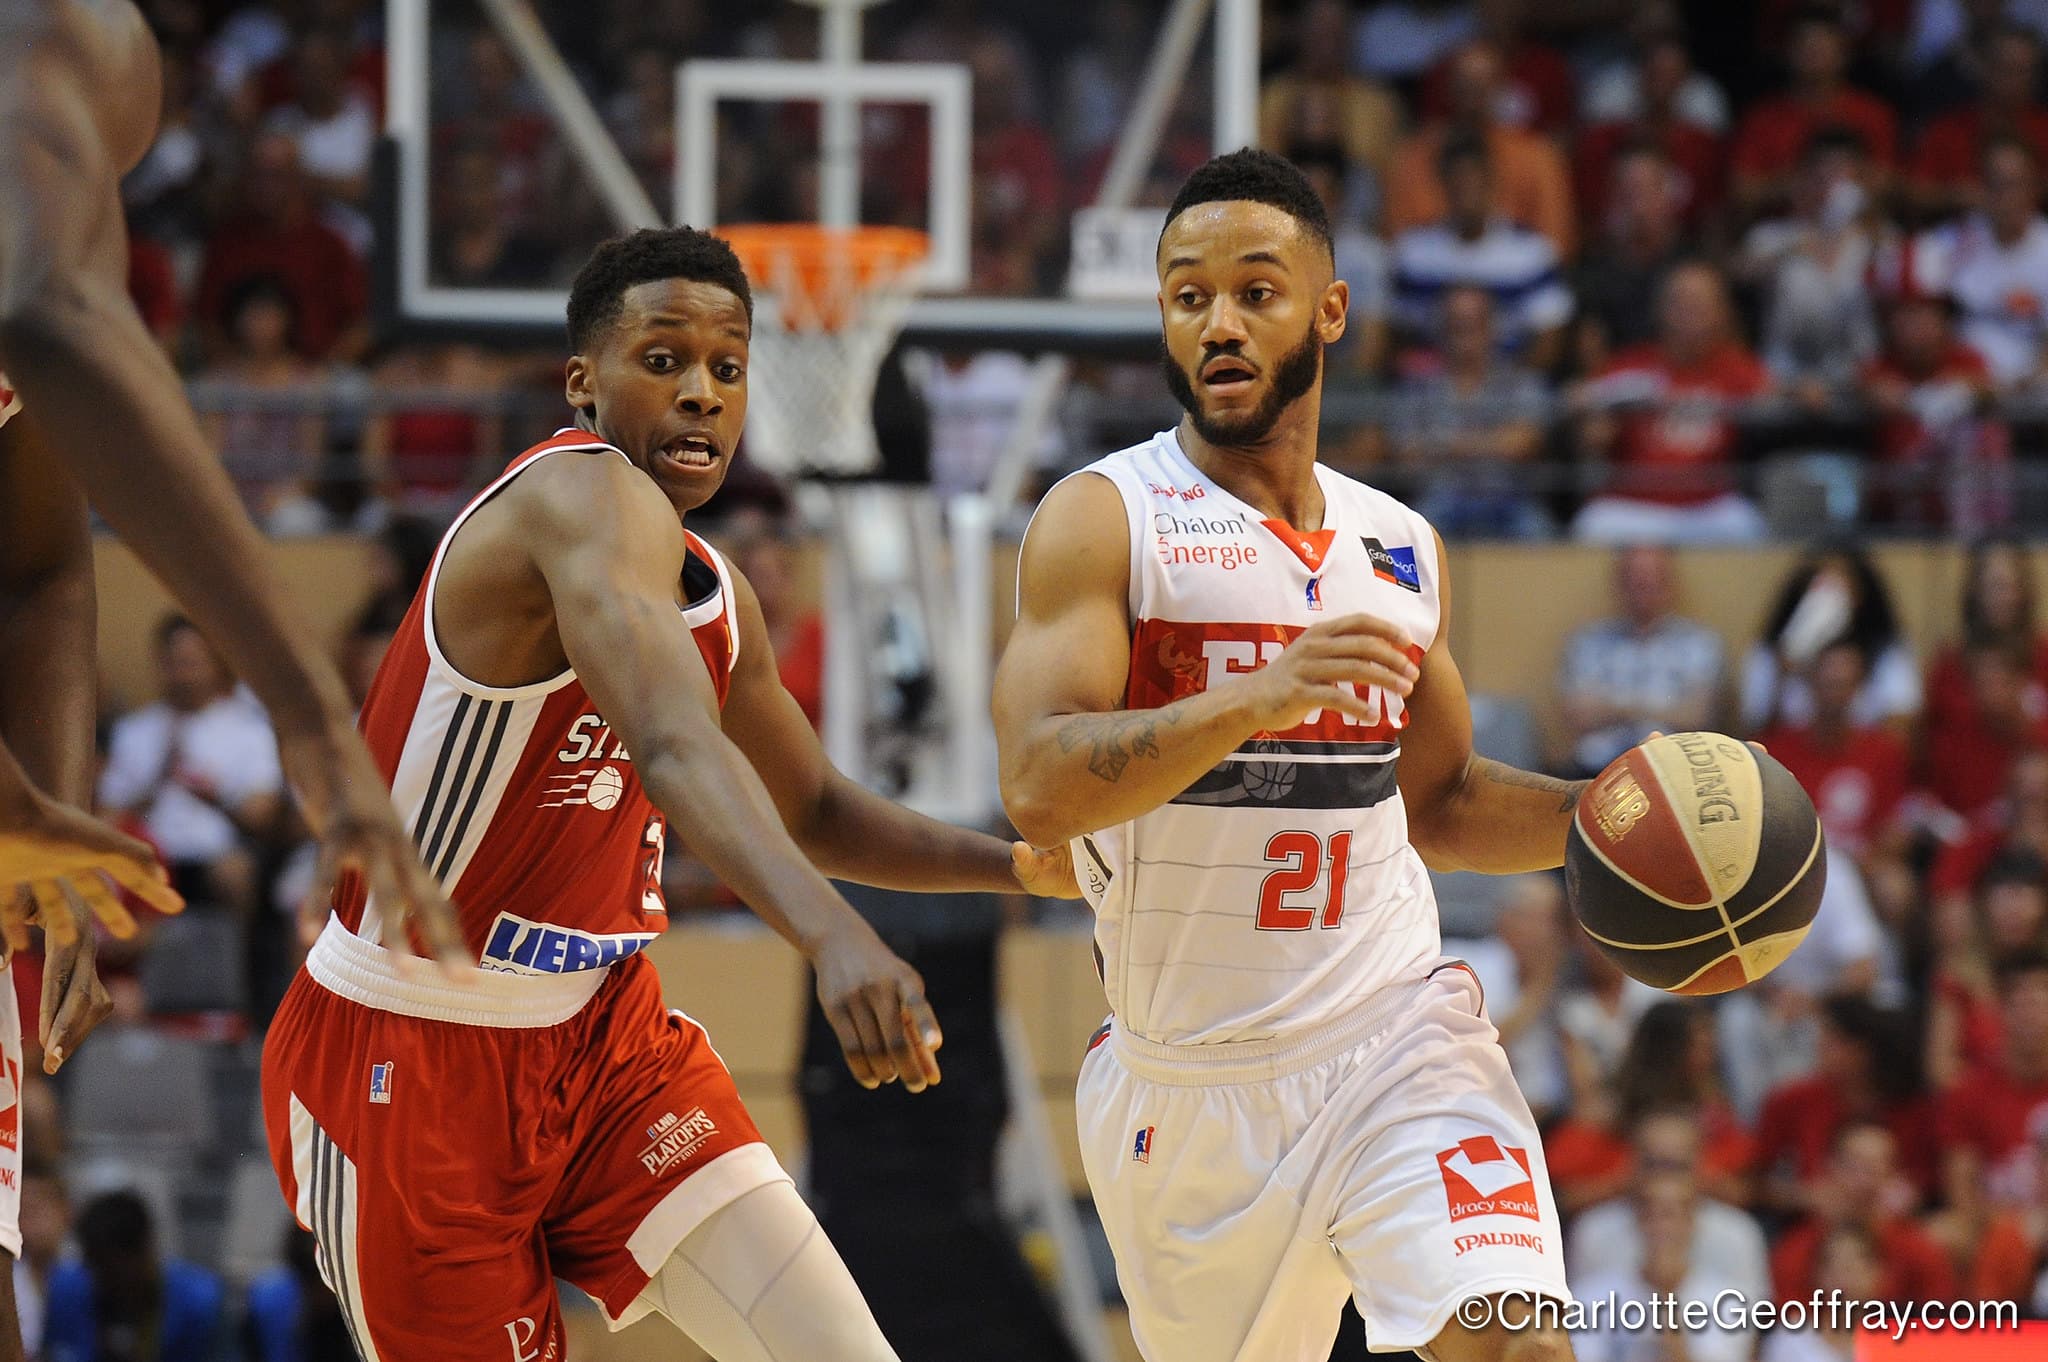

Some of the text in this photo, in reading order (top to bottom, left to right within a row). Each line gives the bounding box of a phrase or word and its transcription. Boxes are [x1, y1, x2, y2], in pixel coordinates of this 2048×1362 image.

[1158, 536, 1258, 570] Énergie
[1255, 830, 1354, 931] 21
[641, 1109, 715, 1175] PLAYOFFS
[1451, 1200, 1496, 1218] dracy
[1453, 1232, 1544, 1257] SPALDING
